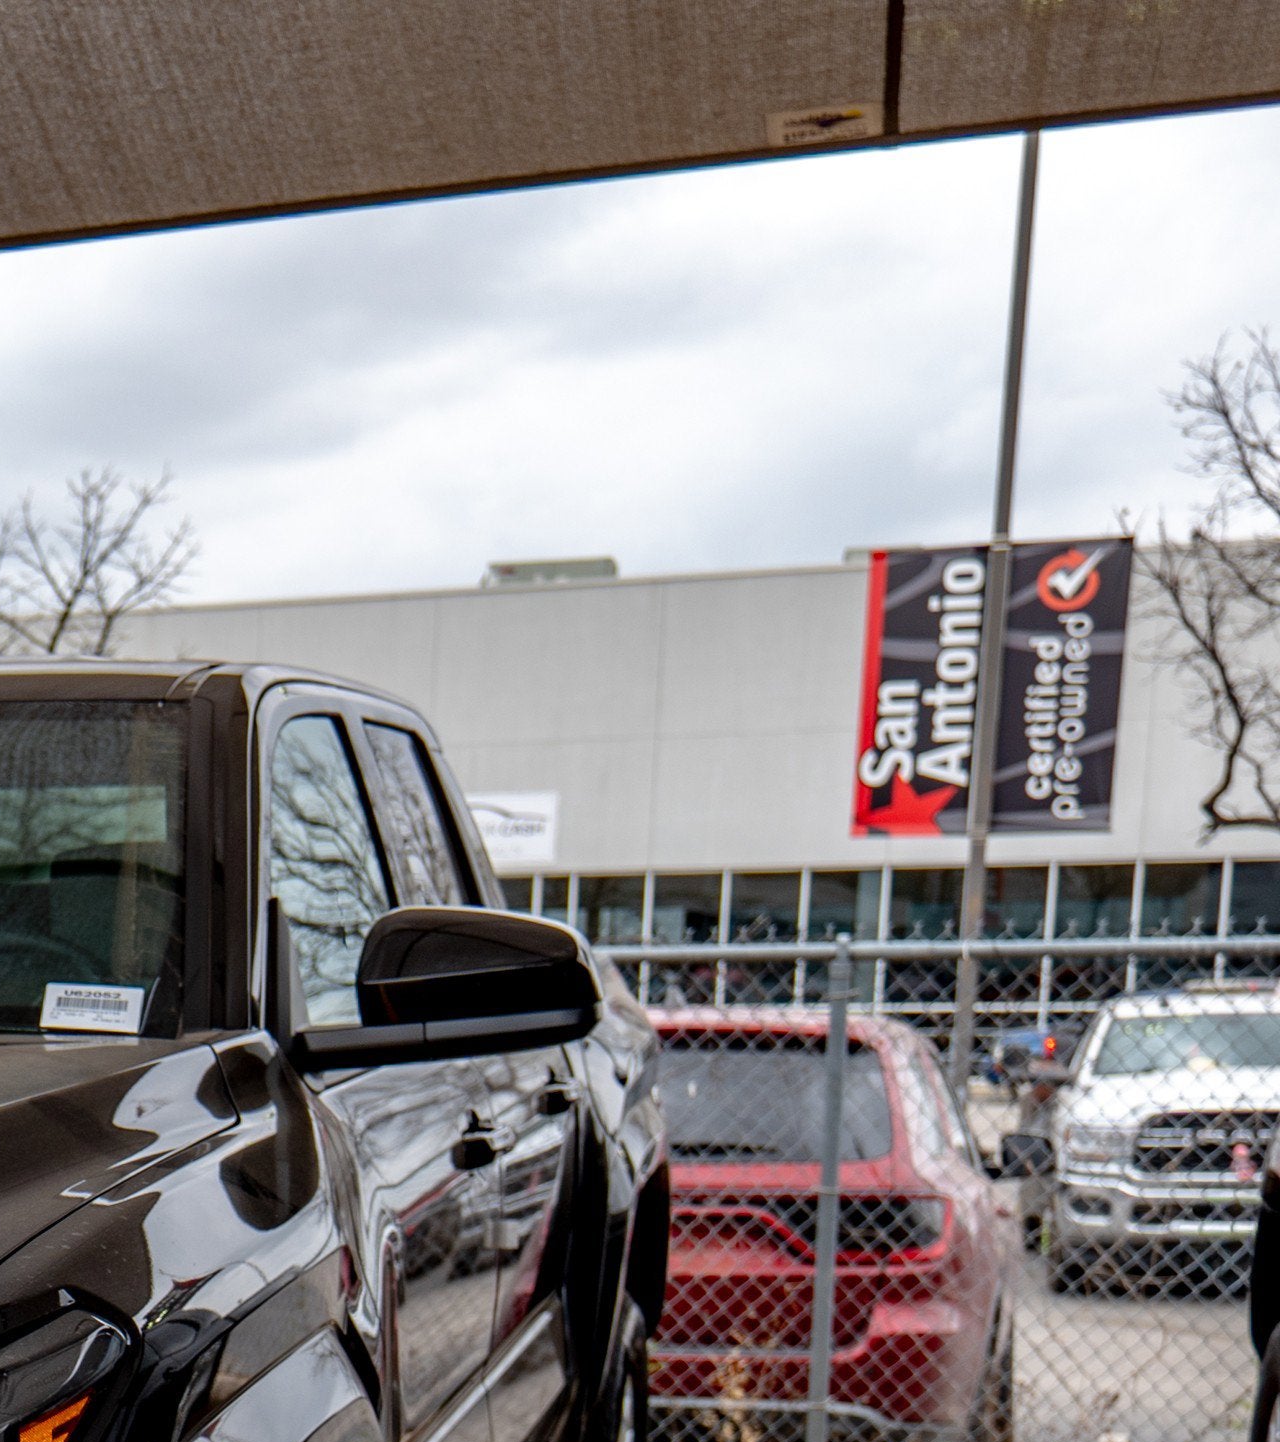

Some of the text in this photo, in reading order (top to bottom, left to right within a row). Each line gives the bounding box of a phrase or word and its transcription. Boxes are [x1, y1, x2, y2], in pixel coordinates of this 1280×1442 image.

[858, 679, 920, 787] San
[916, 557, 986, 787] Antonio
[1024, 636, 1063, 800] certified
[1051, 612, 1095, 821] pre-owned
